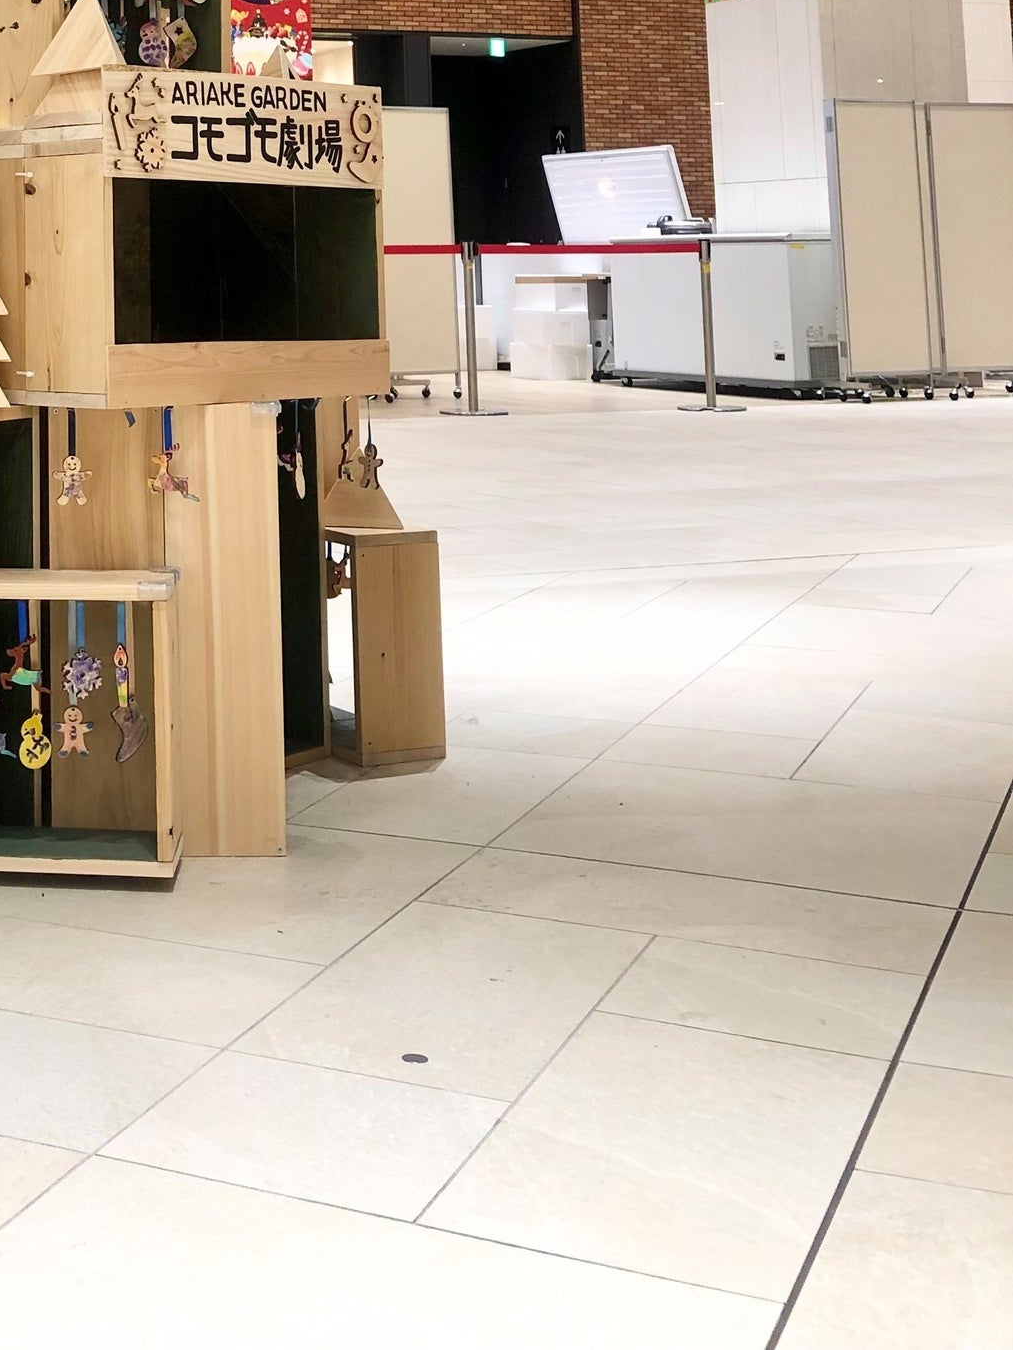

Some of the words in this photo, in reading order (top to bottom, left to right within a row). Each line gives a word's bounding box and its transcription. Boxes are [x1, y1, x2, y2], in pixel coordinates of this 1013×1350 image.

[171, 80, 247, 108] ARIAKE
[250, 84, 327, 113] GARDEN
[170, 108, 344, 174] コモゴモ劇場
